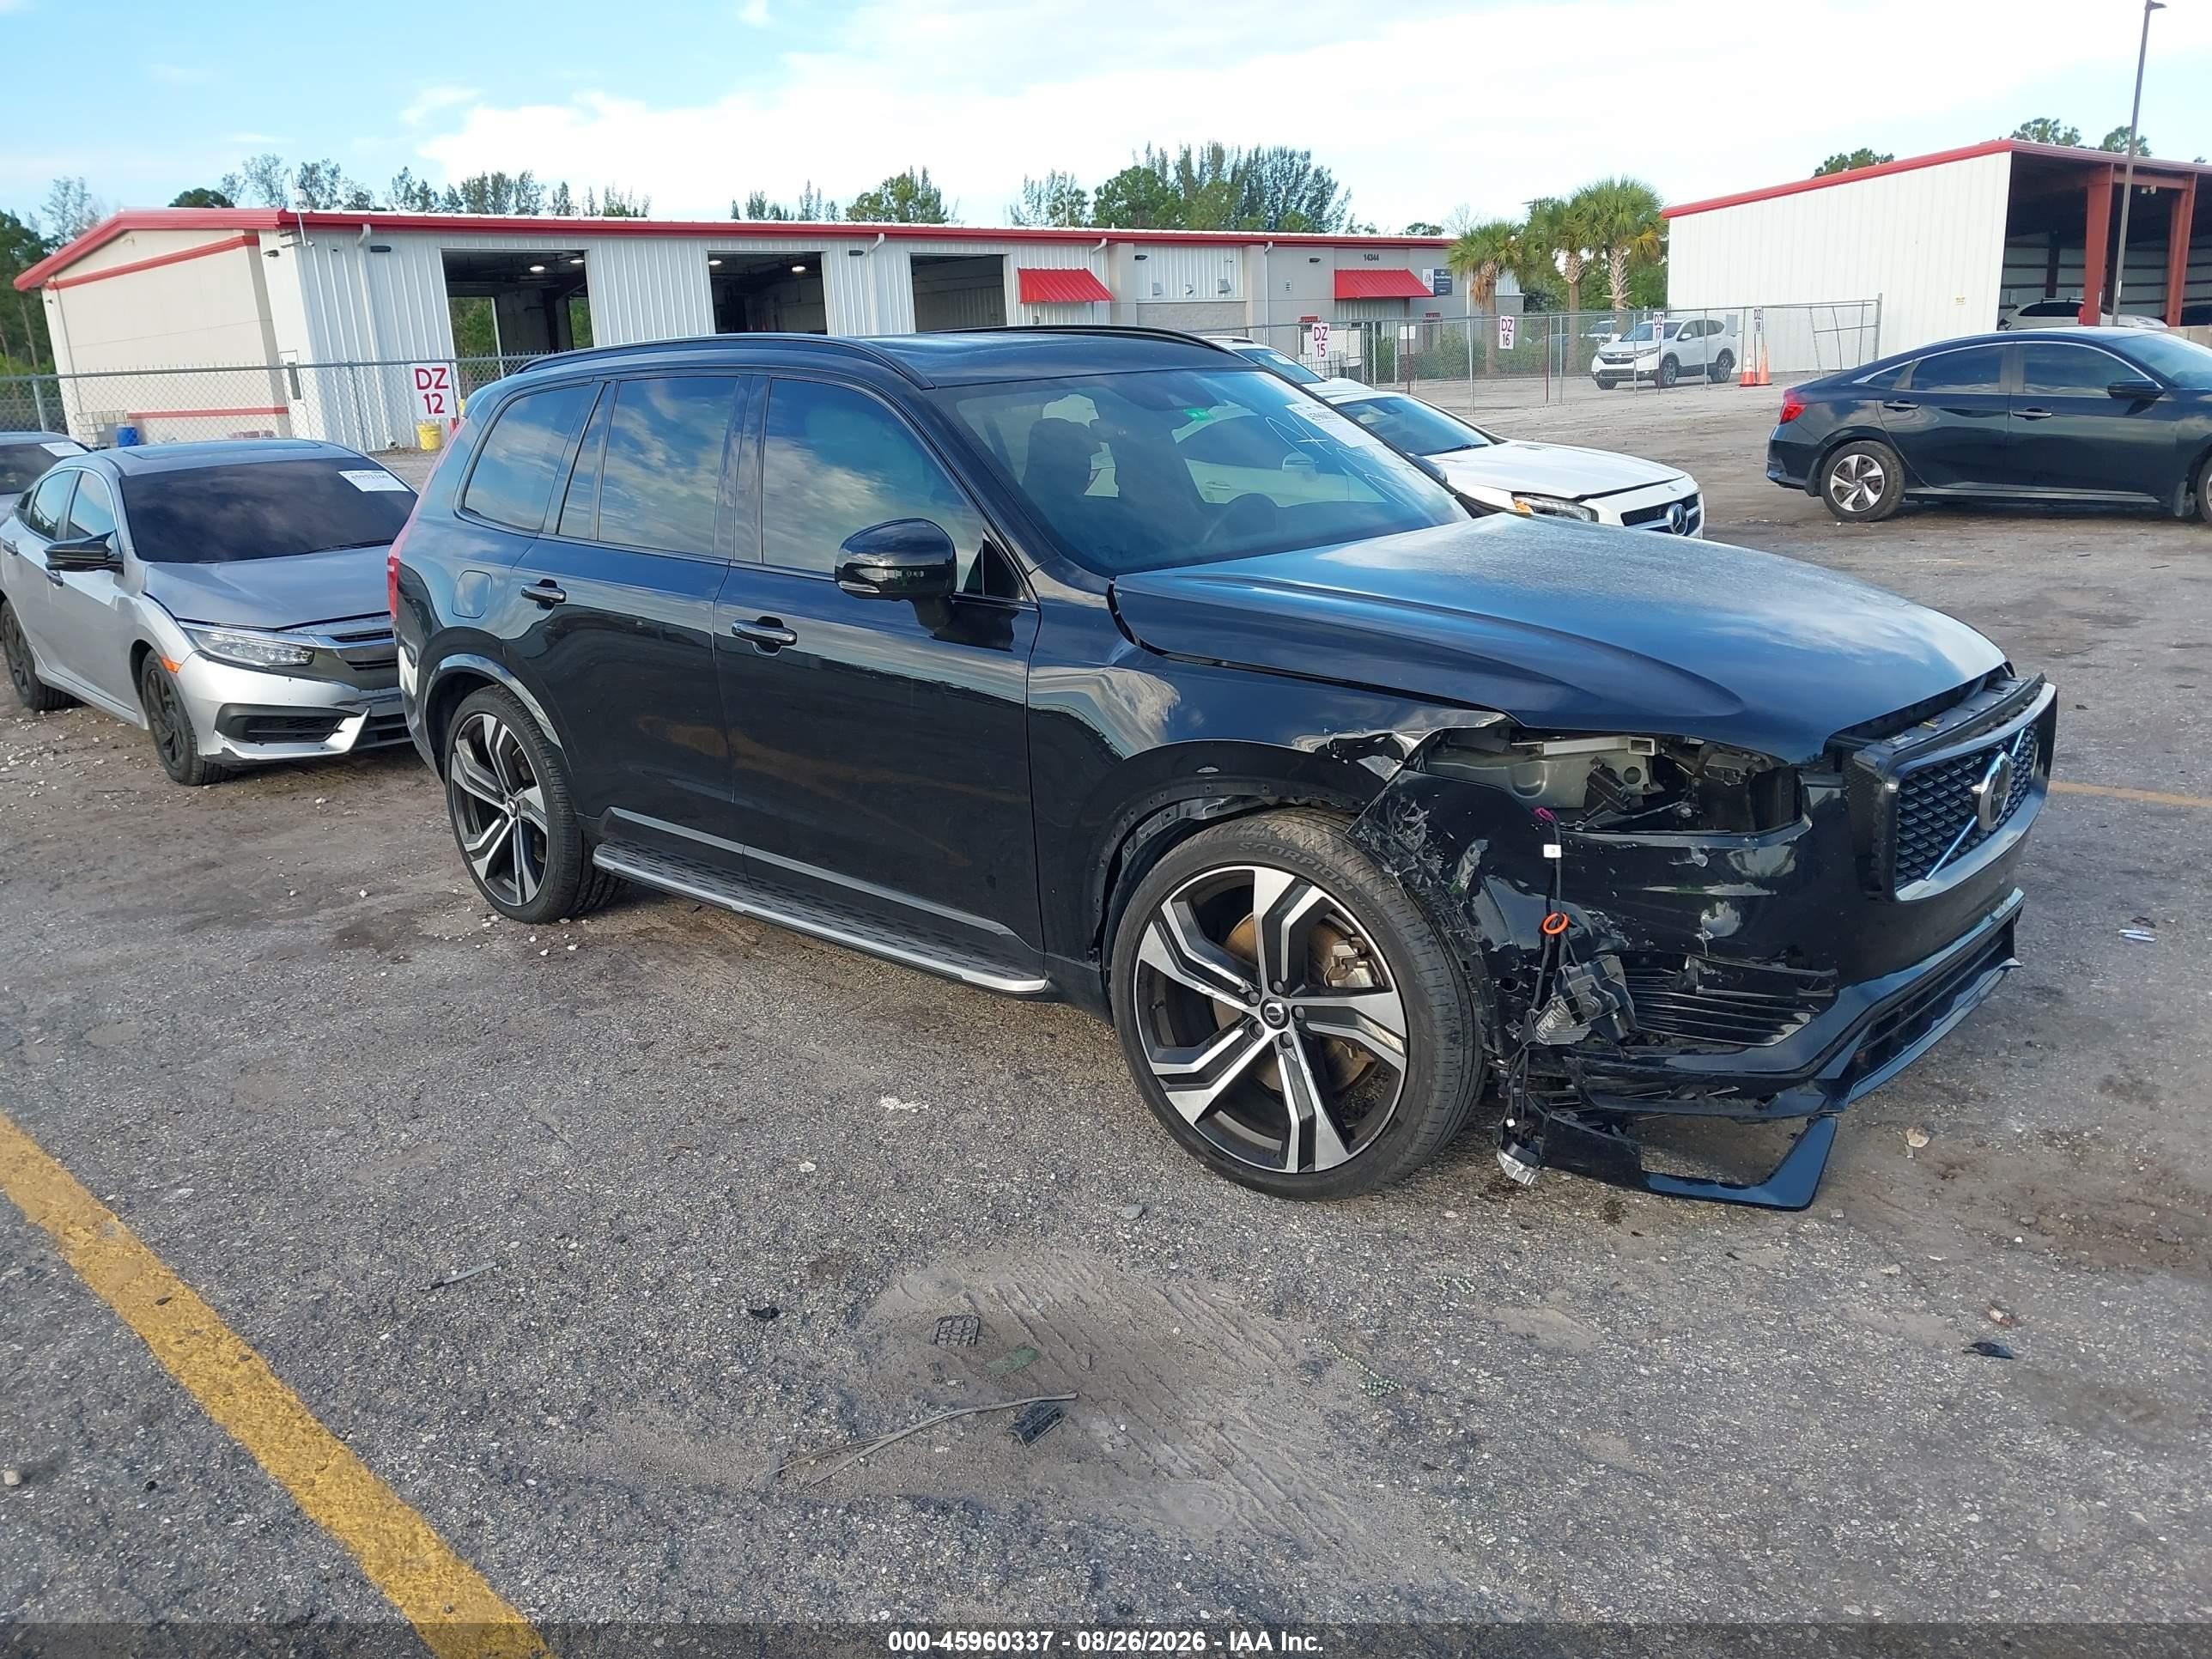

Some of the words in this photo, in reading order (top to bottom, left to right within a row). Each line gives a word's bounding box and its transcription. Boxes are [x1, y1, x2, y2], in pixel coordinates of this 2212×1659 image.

[1654, 314, 1663, 325] DZ
[1753, 309, 1761, 319] DZ
[1501, 319, 1513, 332] DZ
[1755, 321, 1761, 331] 18
[1314, 326, 1328, 341] DZ
[1656, 327, 1662, 338] 17
[1503, 333, 1510, 346] 16
[1316, 343, 1326, 357] 15
[415, 368, 449, 390] DZ
[422, 392, 446, 414] 12
[1237, 841, 1354, 892] SCORPION
